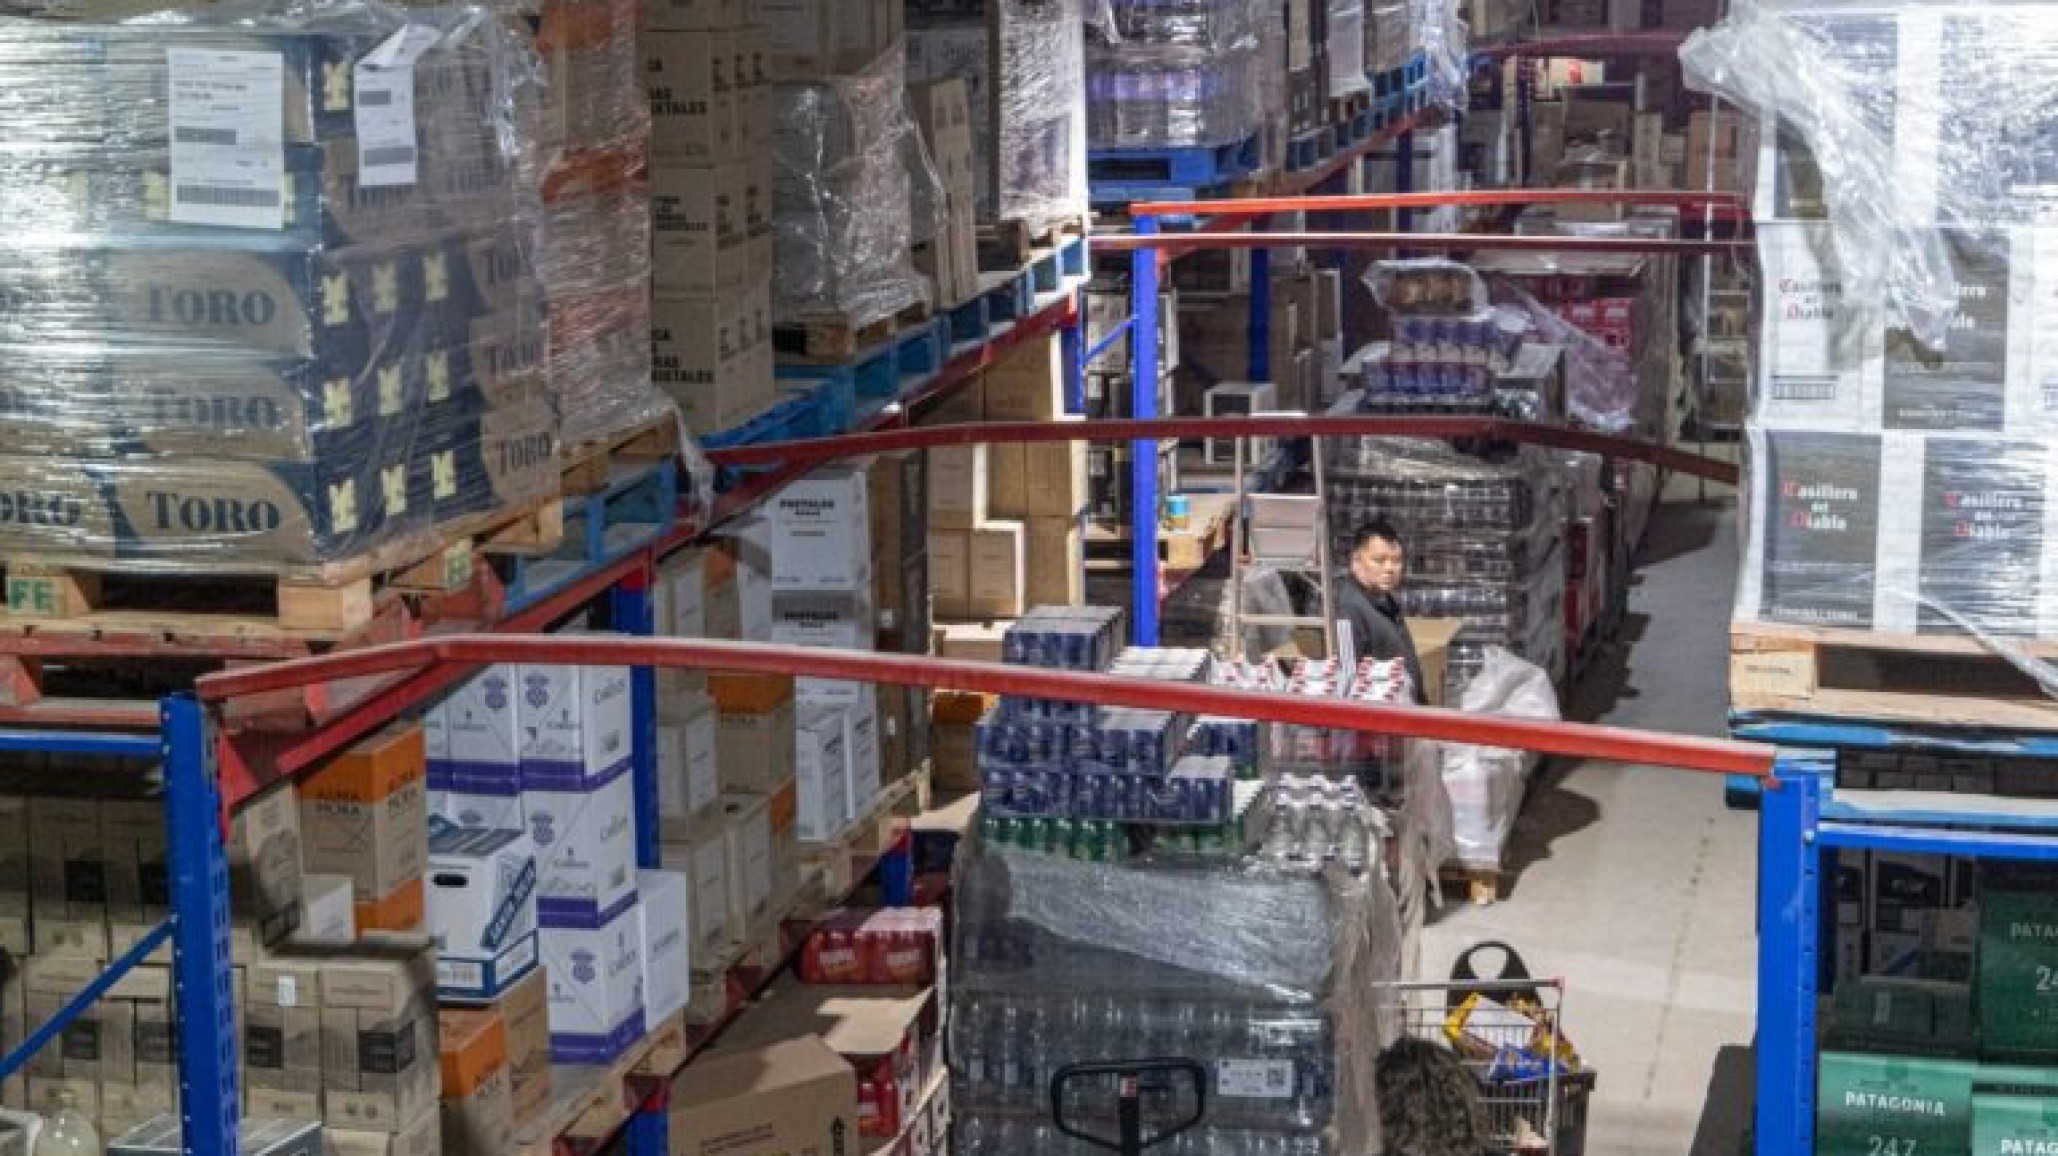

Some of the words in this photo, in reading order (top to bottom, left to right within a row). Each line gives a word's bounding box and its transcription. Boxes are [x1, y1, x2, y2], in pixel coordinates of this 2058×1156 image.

[150, 282, 277, 324] TORO
[147, 491, 281, 532] TORO
[1846, 1091, 1946, 1117] PATAGONIA
